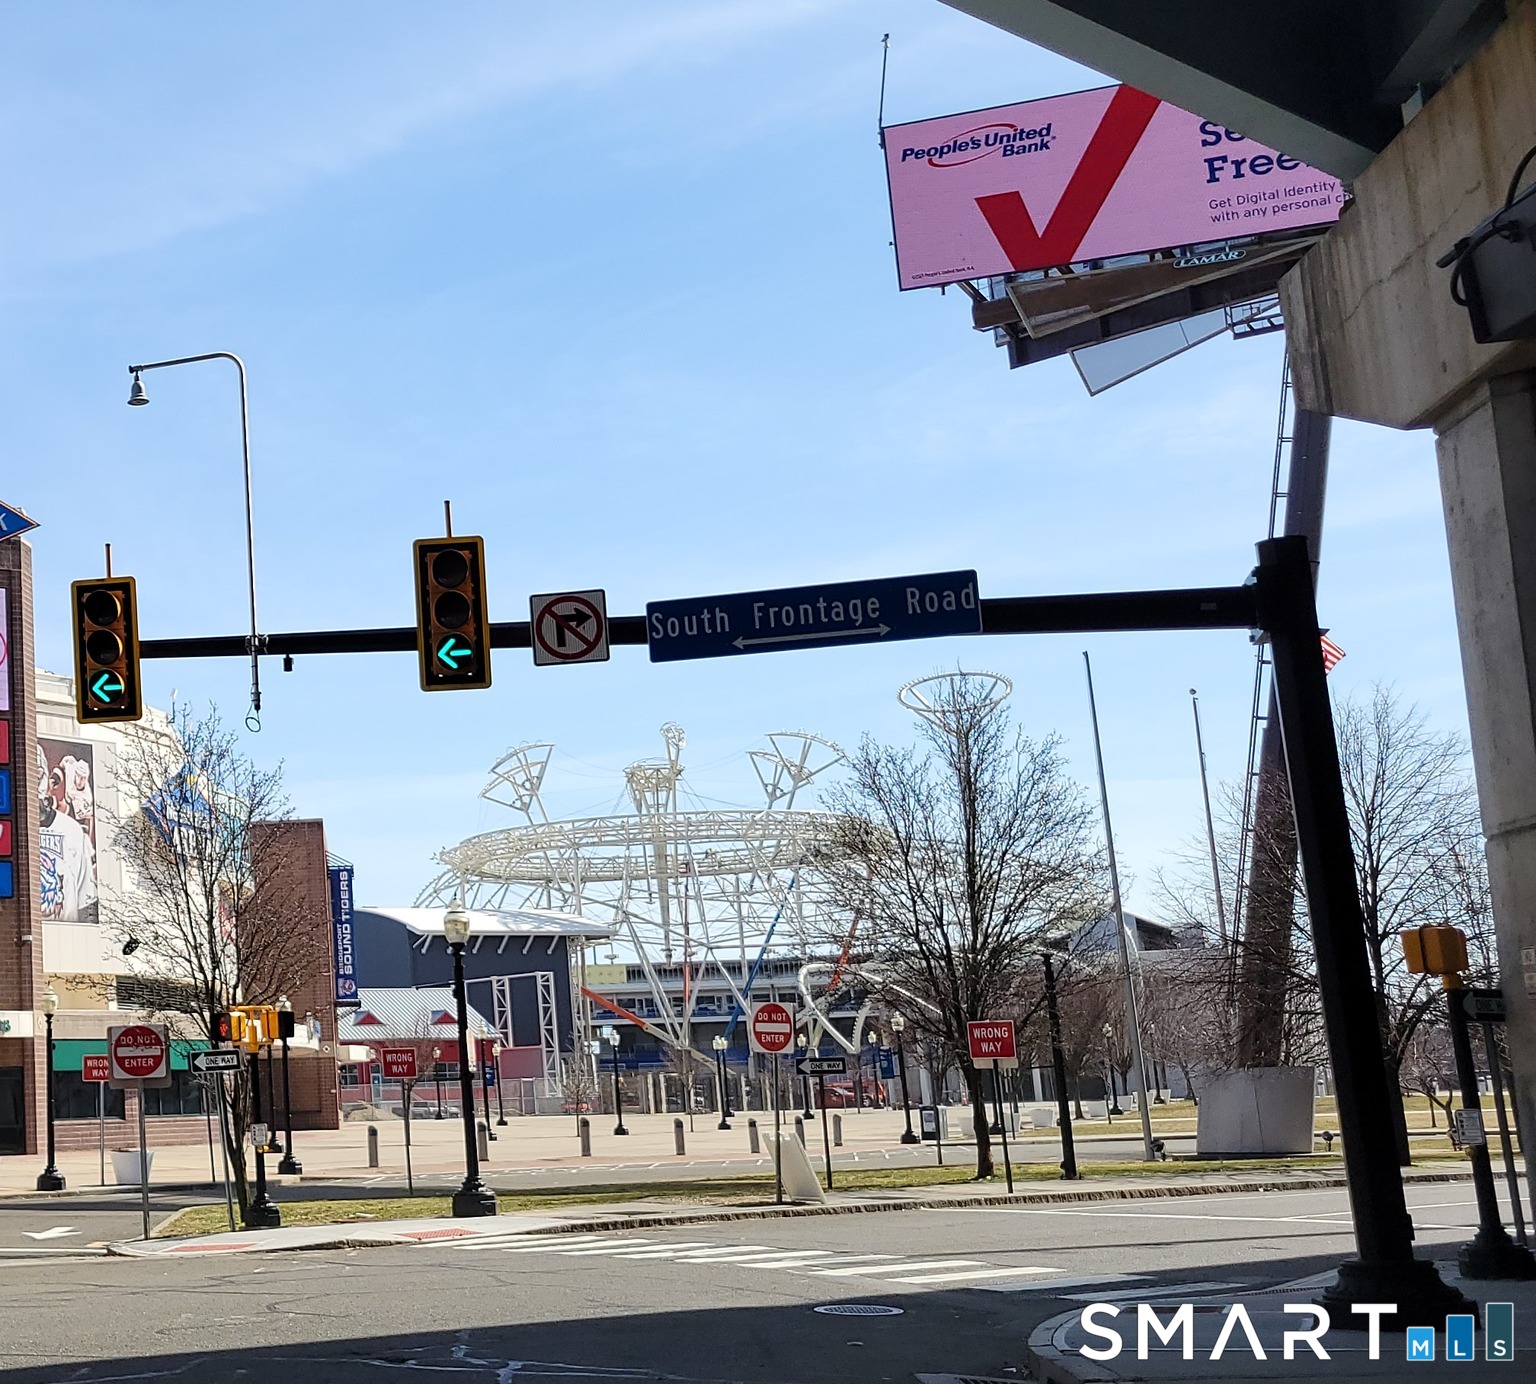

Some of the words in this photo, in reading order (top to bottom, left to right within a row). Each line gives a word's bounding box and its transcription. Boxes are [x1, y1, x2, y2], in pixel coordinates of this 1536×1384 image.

[901, 136, 981, 162] People's
[984, 123, 1052, 147] United
[1002, 138, 1051, 157] Bank
[1209, 197, 1232, 209] Get
[1236, 189, 1280, 206] Digital
[1284, 181, 1336, 196] Identity
[1210, 209, 1239, 222] with
[1244, 206, 1268, 218] any
[1272, 195, 1331, 215] personal
[1180, 251, 1239, 267] LAMAR
[651, 606, 730, 640] South
[752, 595, 880, 629] Frontage
[906, 581, 975, 614] Road
[340, 871, 350, 922] TIGERS
[342, 923, 353, 975] SOUND
[758, 1012, 768, 1021] DO
[771, 1012, 786, 1021] NOT
[761, 1034, 784, 1043] ENTER
[972, 1027, 1009, 1039] WRONG
[120, 1035, 133, 1045] DO
[139, 1035, 156, 1044] NOT
[981, 1041, 1002, 1053] WAY
[86, 1059, 108, 1067] WRON
[124, 1058, 154, 1067] ENTER
[205, 1057, 219, 1065] ONE
[221, 1056, 234, 1064] WAY
[386, 1052, 412, 1062] WRONG
[92, 1069, 108, 1077] WAY
[391, 1064, 408, 1073] WAY
